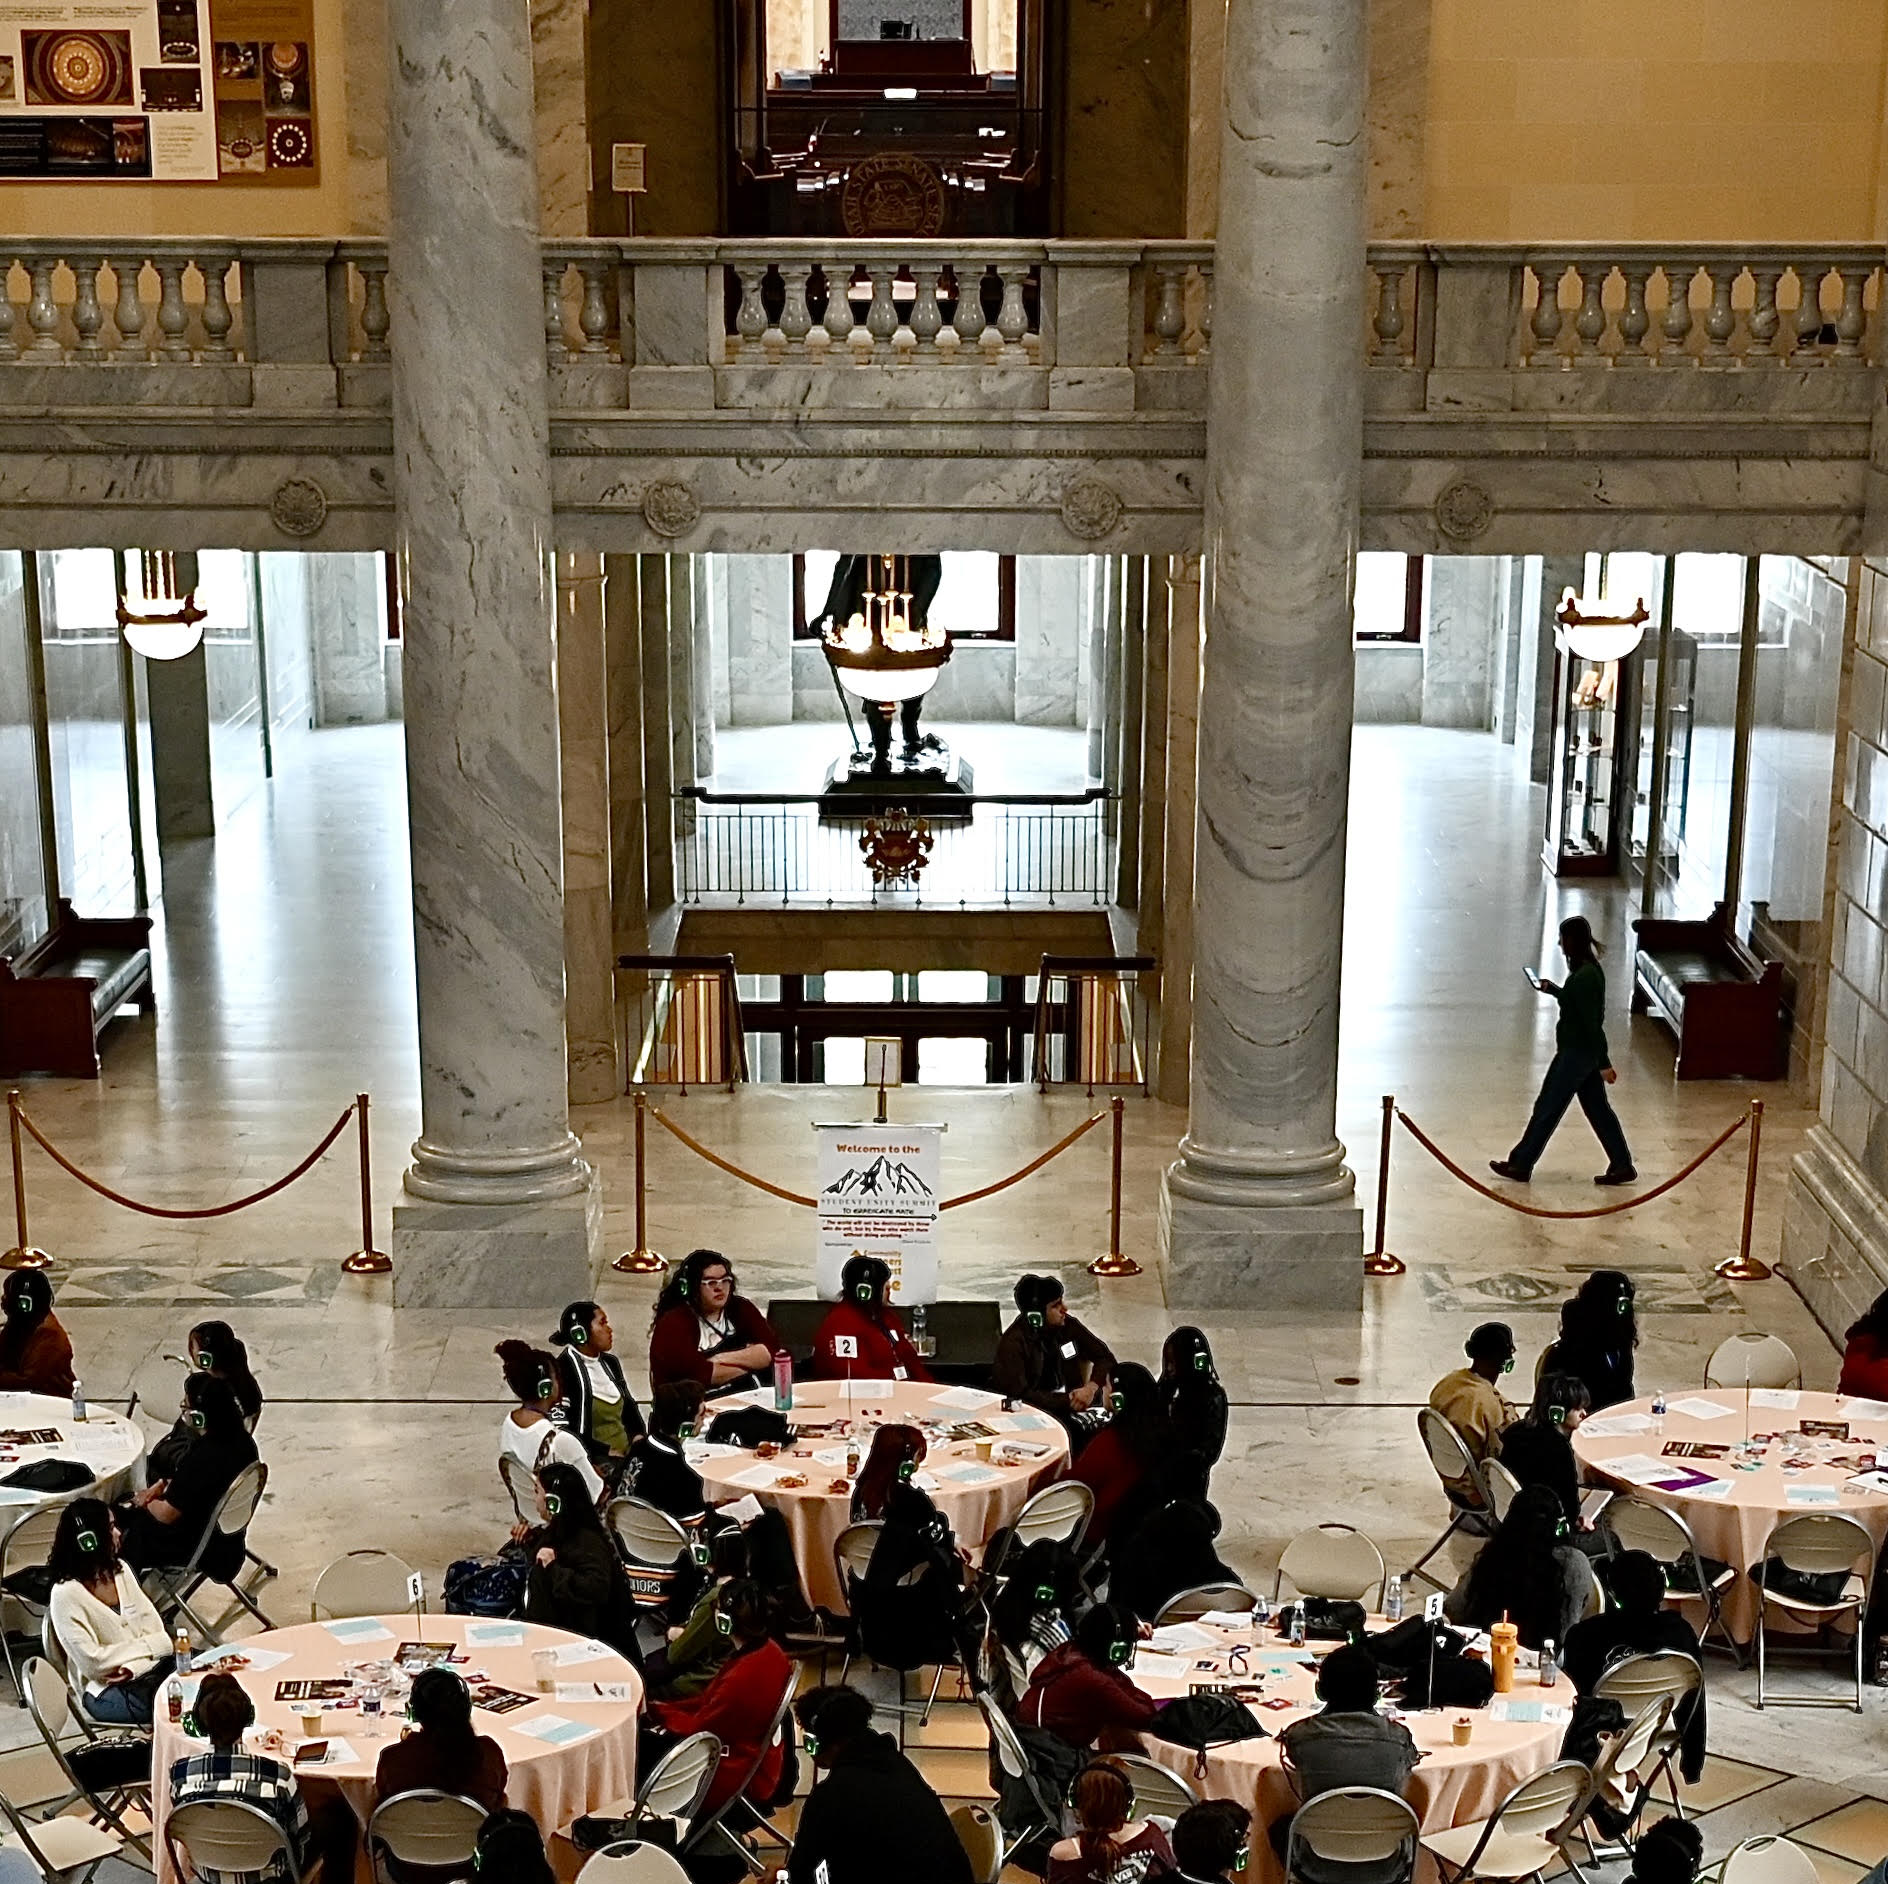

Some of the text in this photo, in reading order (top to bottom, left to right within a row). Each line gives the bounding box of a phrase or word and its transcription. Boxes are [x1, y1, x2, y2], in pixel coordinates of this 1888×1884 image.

[837, 1144, 920, 1154] Welcome to the
[842, 1339, 851, 1354] 2
[412, 1578, 419, 1595] 6
[1431, 1598, 1438, 1616] 5
